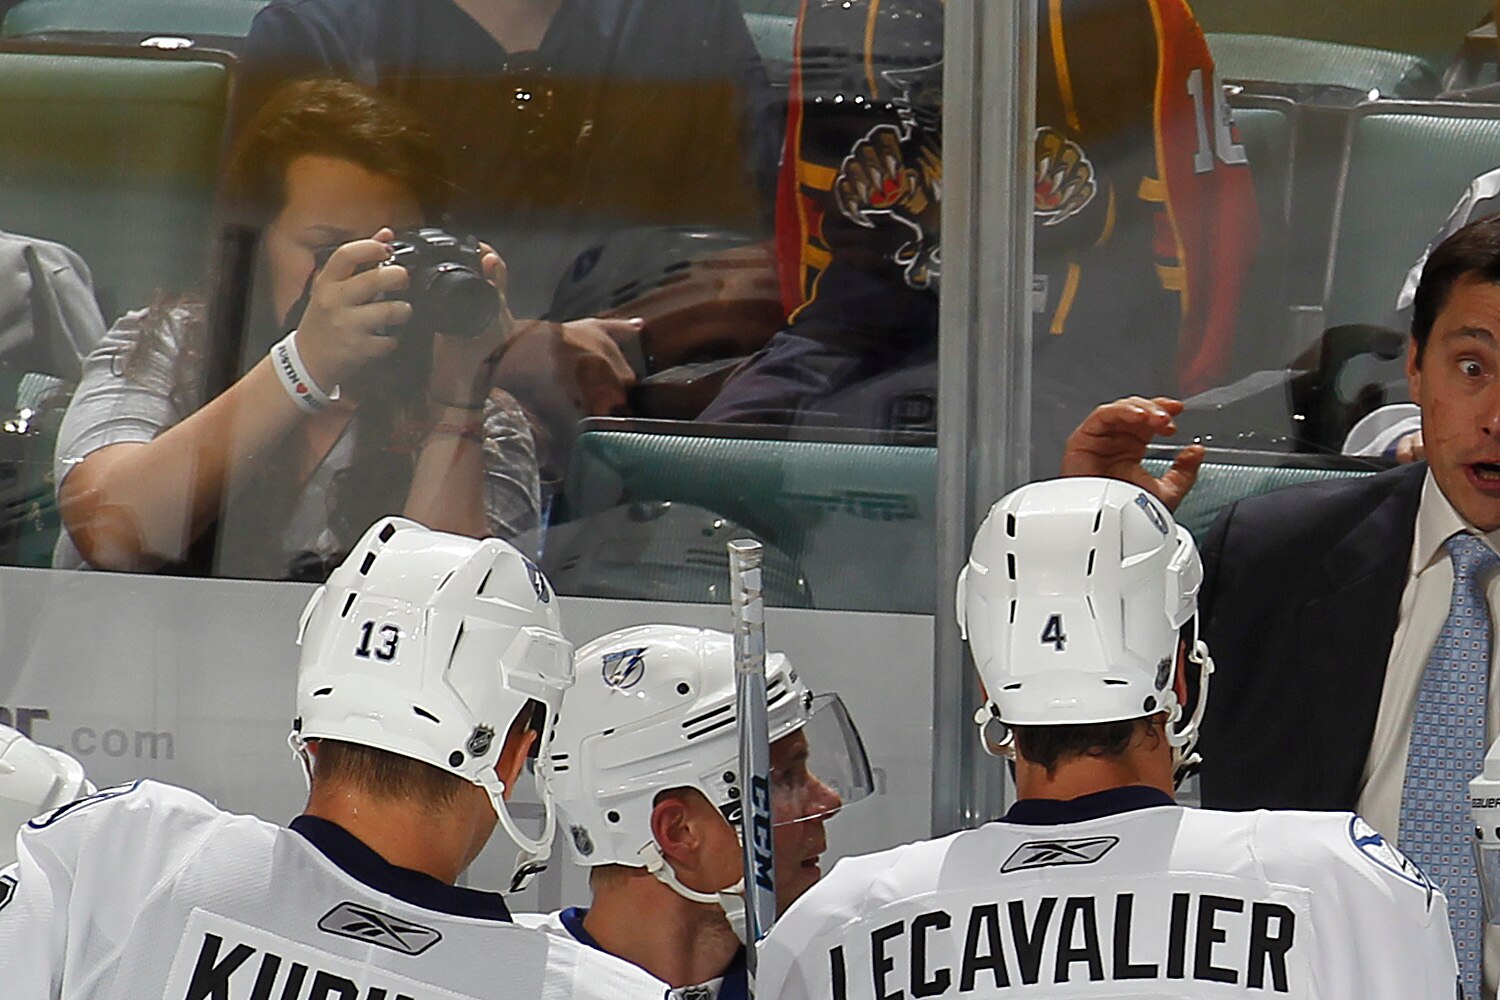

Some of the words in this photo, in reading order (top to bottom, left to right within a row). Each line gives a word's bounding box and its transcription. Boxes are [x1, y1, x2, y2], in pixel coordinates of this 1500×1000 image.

[354, 610, 399, 662] 13
[1040, 614, 1066, 652] 4
[752, 775, 774, 892] CCM
